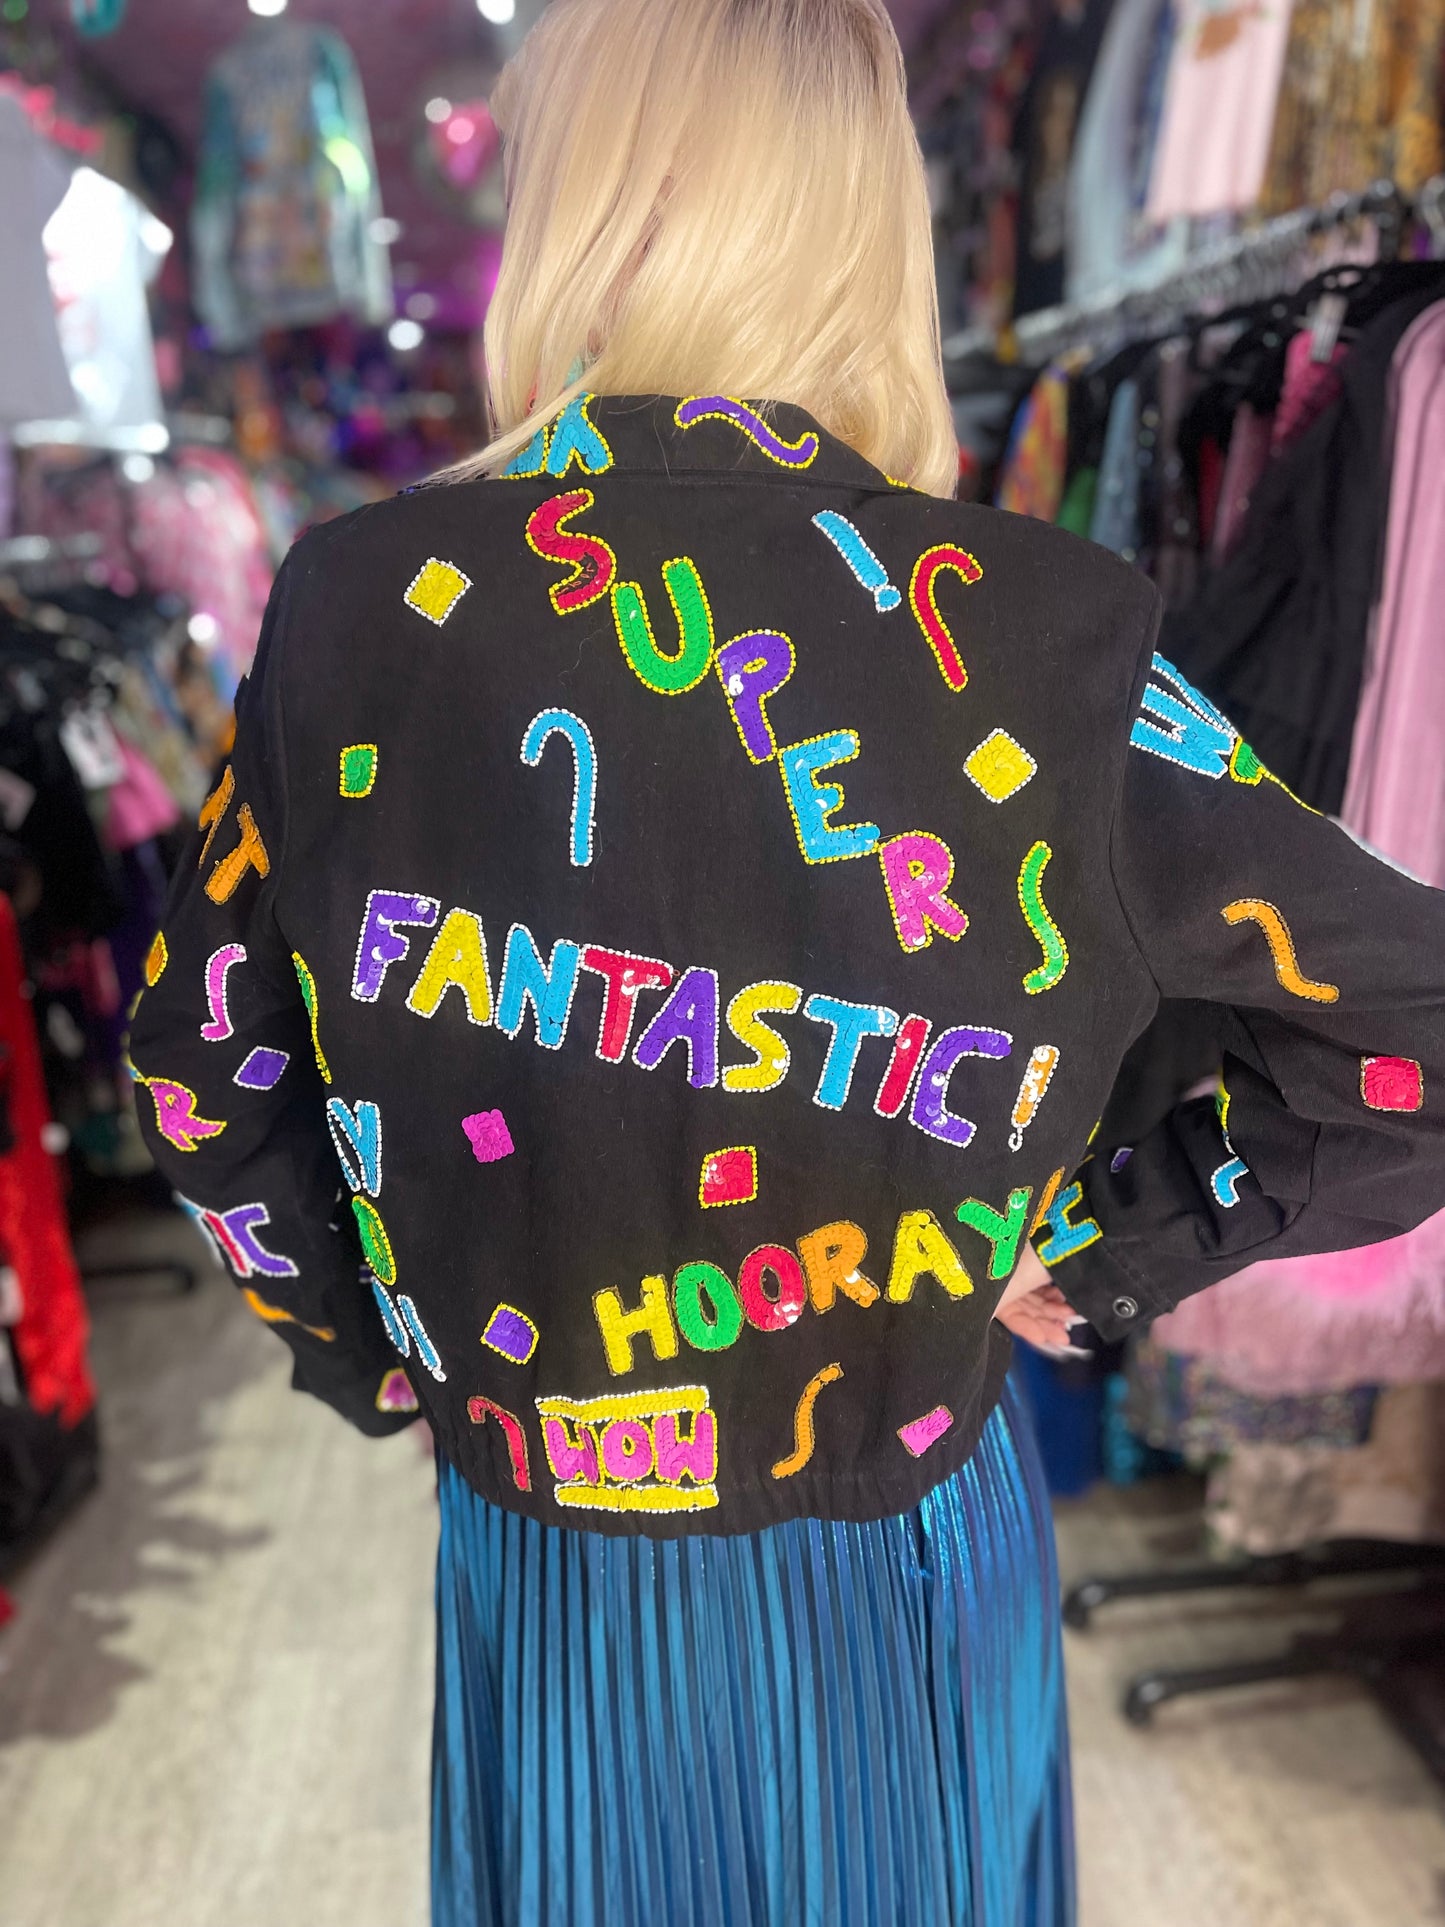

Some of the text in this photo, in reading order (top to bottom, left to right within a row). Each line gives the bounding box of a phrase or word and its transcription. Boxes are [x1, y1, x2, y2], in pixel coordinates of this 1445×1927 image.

[524, 488, 970, 953] SUPER
[350, 888, 1061, 1152] FANTASTIC!
[539, 1408, 719, 1488] WOW
